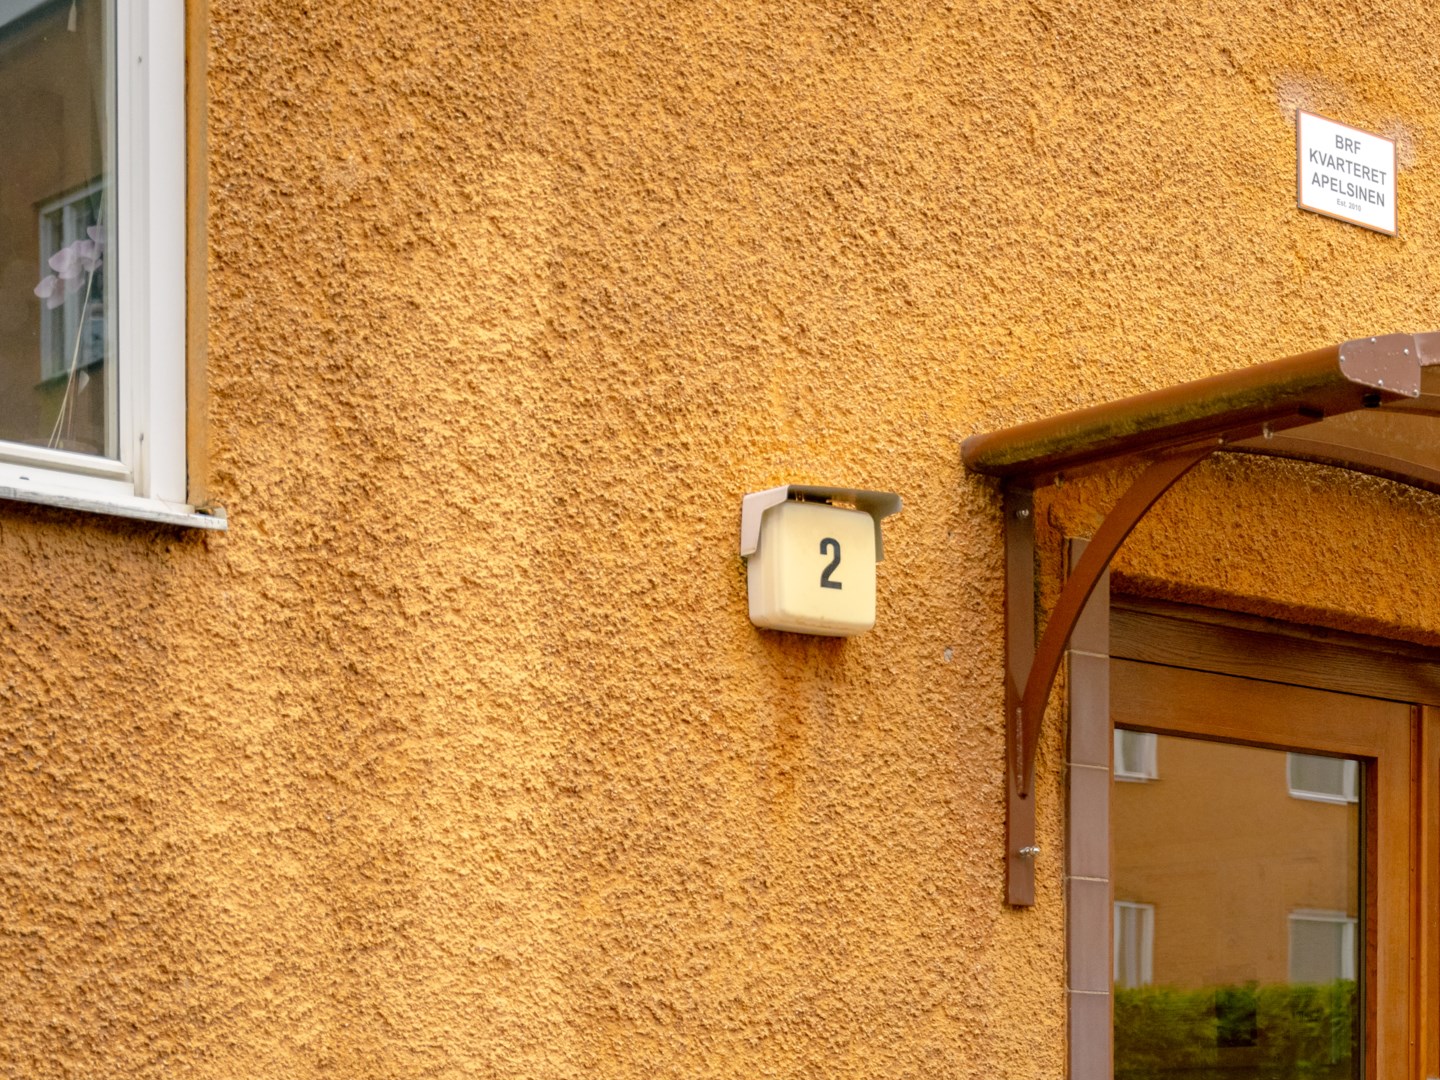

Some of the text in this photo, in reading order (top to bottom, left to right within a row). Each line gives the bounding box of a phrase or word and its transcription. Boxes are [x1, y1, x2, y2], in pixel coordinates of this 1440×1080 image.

[1335, 134, 1361, 154] BRF
[1309, 148, 1387, 185] KVARTERET
[1311, 172, 1385, 207] APELSINEN
[1336, 198, 1362, 212] Est. 2010
[820, 537, 842, 590] 2
